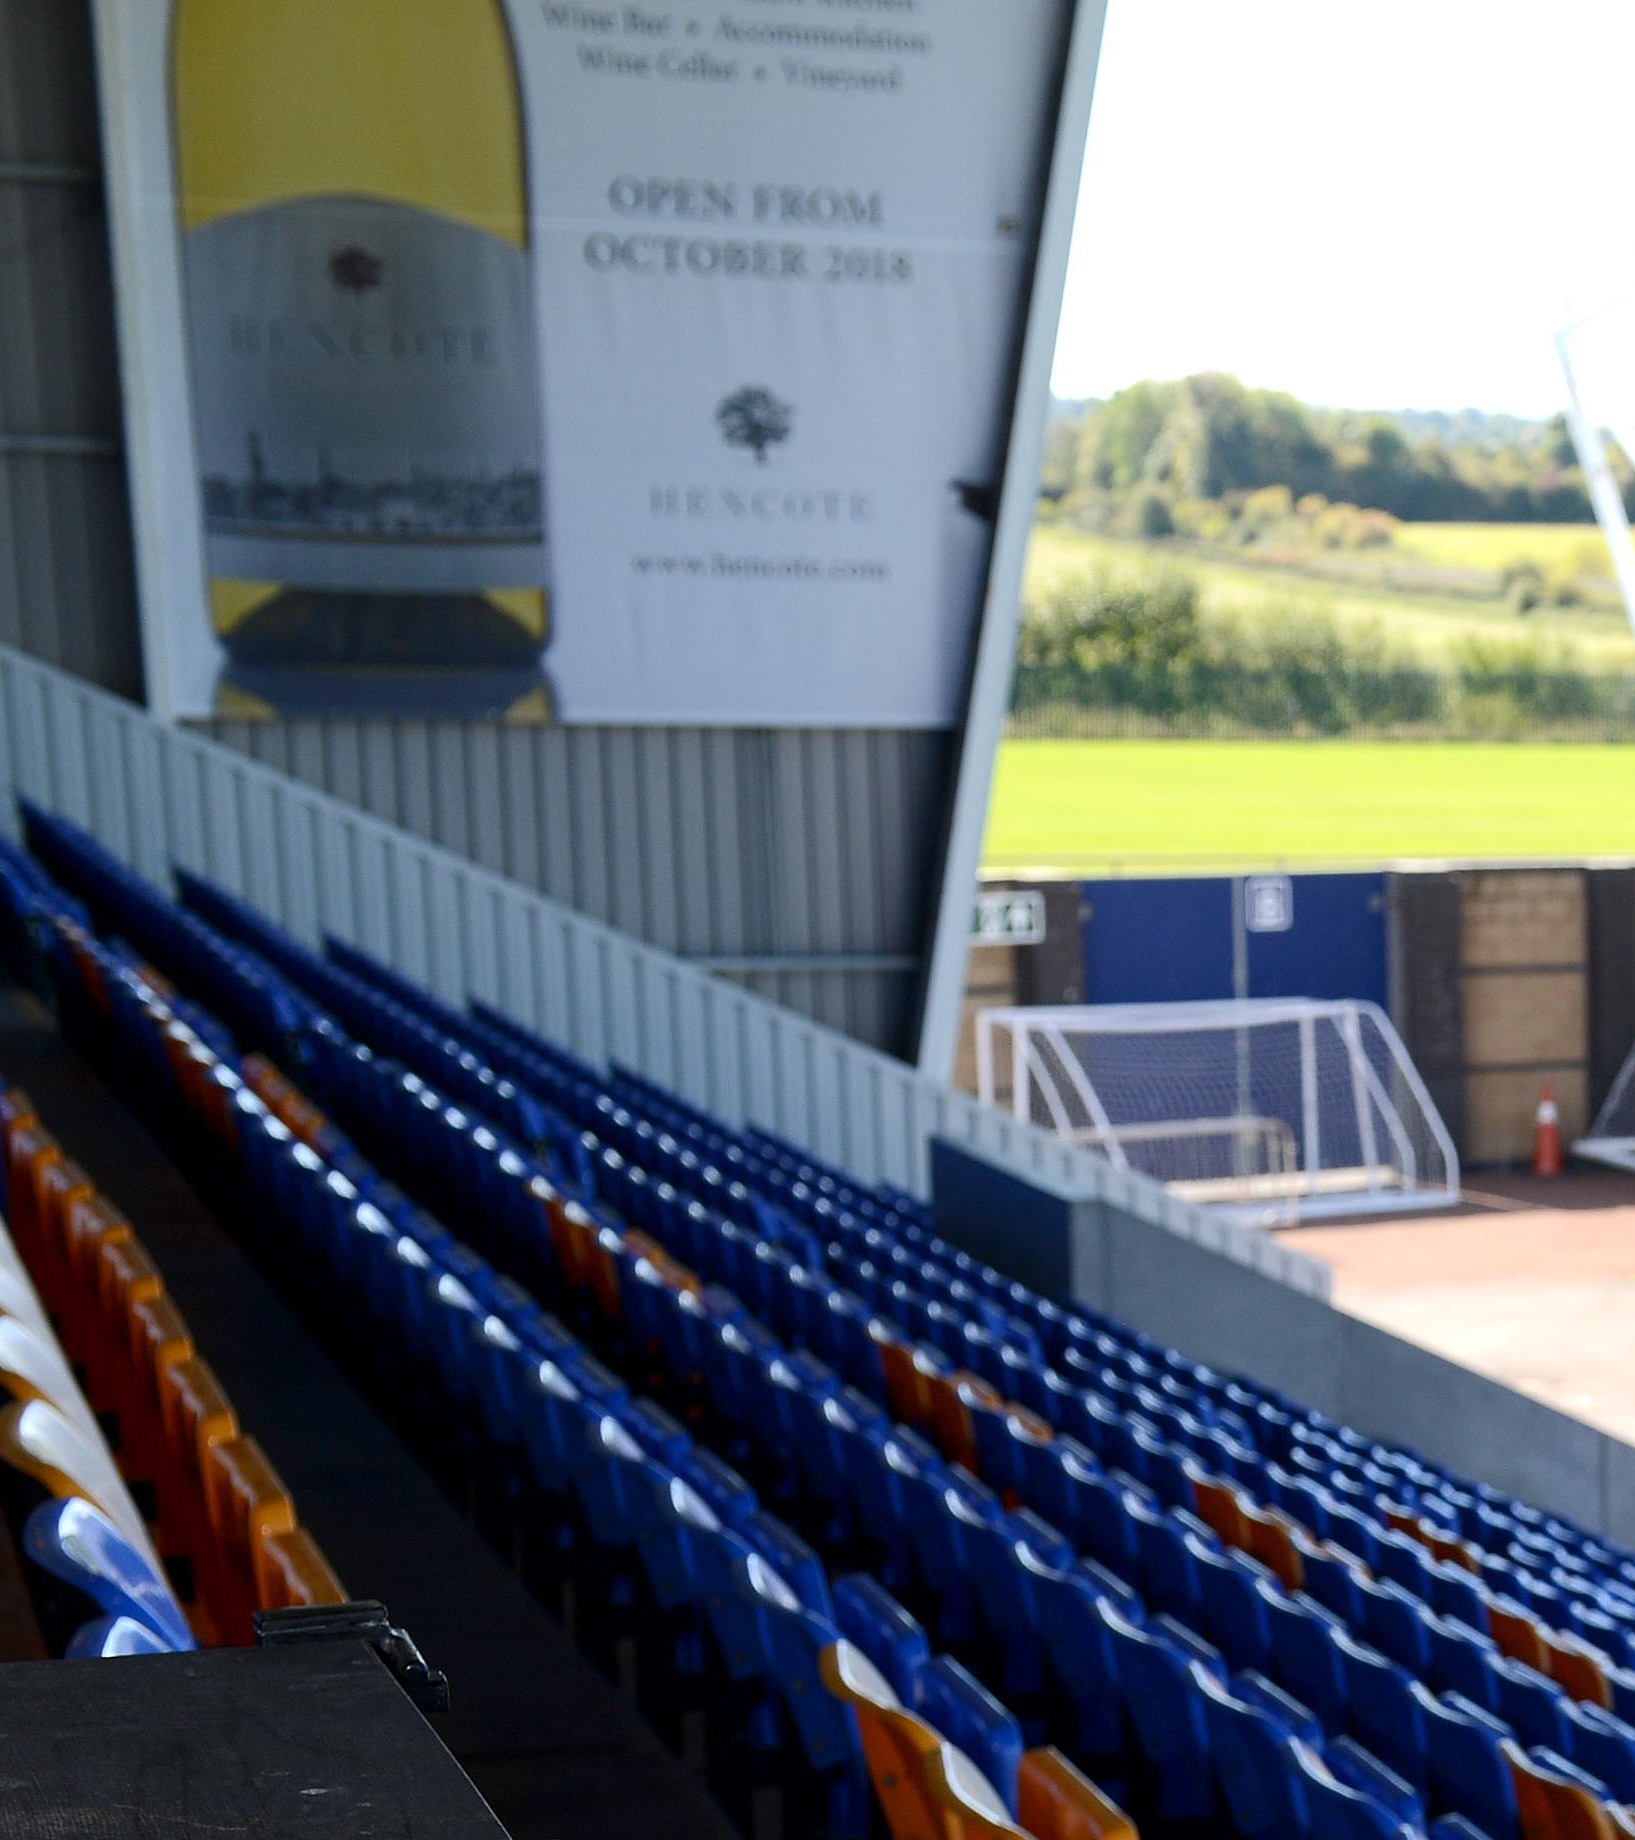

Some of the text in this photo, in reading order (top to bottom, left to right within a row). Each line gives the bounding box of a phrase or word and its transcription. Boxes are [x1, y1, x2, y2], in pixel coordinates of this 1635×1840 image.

[608, 175, 883, 225] OPEN FROM
[584, 231, 912, 282] OCTOBER 2018
[647, 485, 878, 522] HENCOTE
